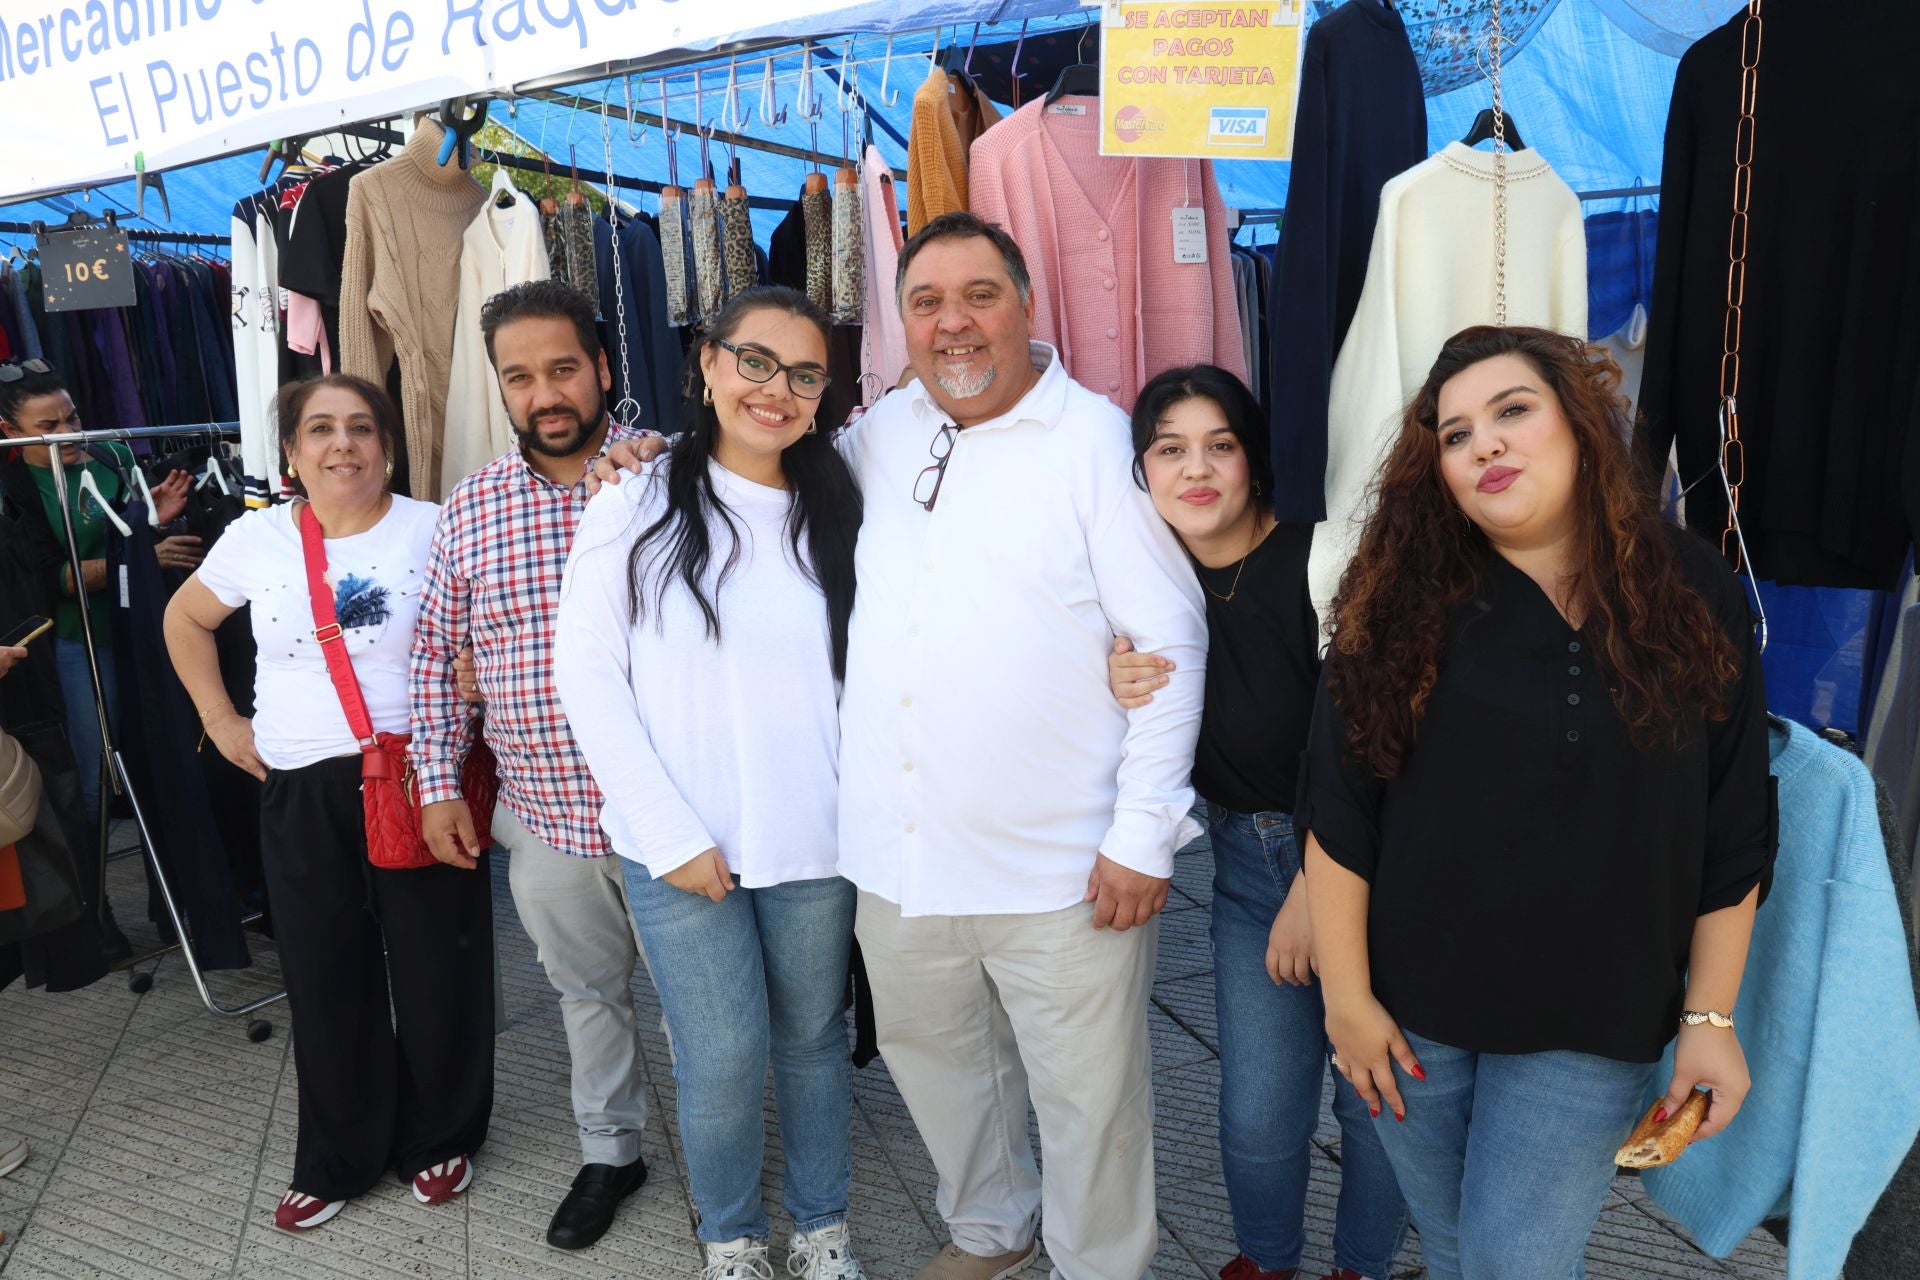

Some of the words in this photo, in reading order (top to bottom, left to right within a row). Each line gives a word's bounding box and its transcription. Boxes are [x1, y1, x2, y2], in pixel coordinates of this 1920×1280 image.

[1125, 11, 1149, 29] SE
[1153, 9, 1269, 28] ACEPTAN
[1153, 37, 1234, 57] PAGOS
[89, 70, 140, 147] El
[146, 31, 323, 134] Puesto
[346, 0, 414, 82] de
[1117, 66, 1168, 85] CON
[1173, 66, 1275, 87] TARJETA
[1218, 119, 1258, 134] VISA
[64, 258, 110, 283] 10€
